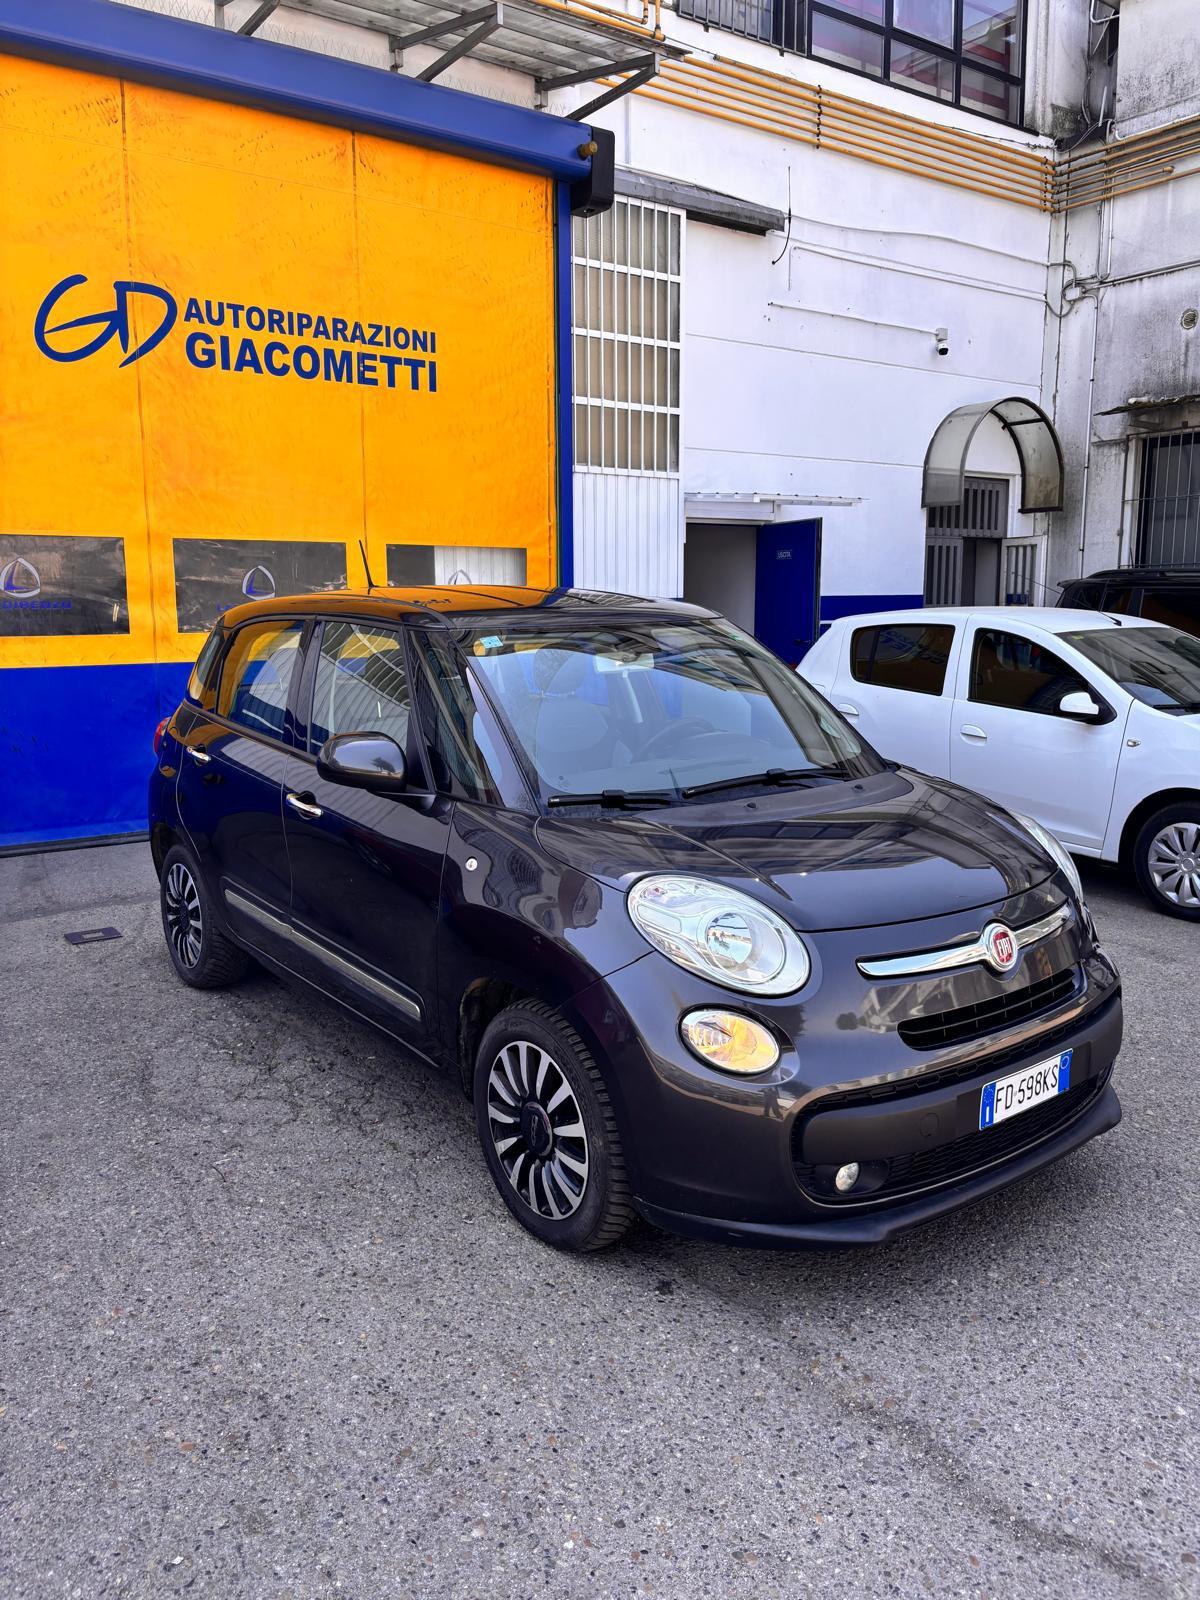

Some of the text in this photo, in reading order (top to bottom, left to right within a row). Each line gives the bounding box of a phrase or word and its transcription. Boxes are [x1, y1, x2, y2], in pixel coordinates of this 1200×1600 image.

[183, 297, 437, 354] AUTORIPARAZIONI
[185, 332, 437, 393] GIACOMETTI
[996, 937, 1011, 957] FIAT
